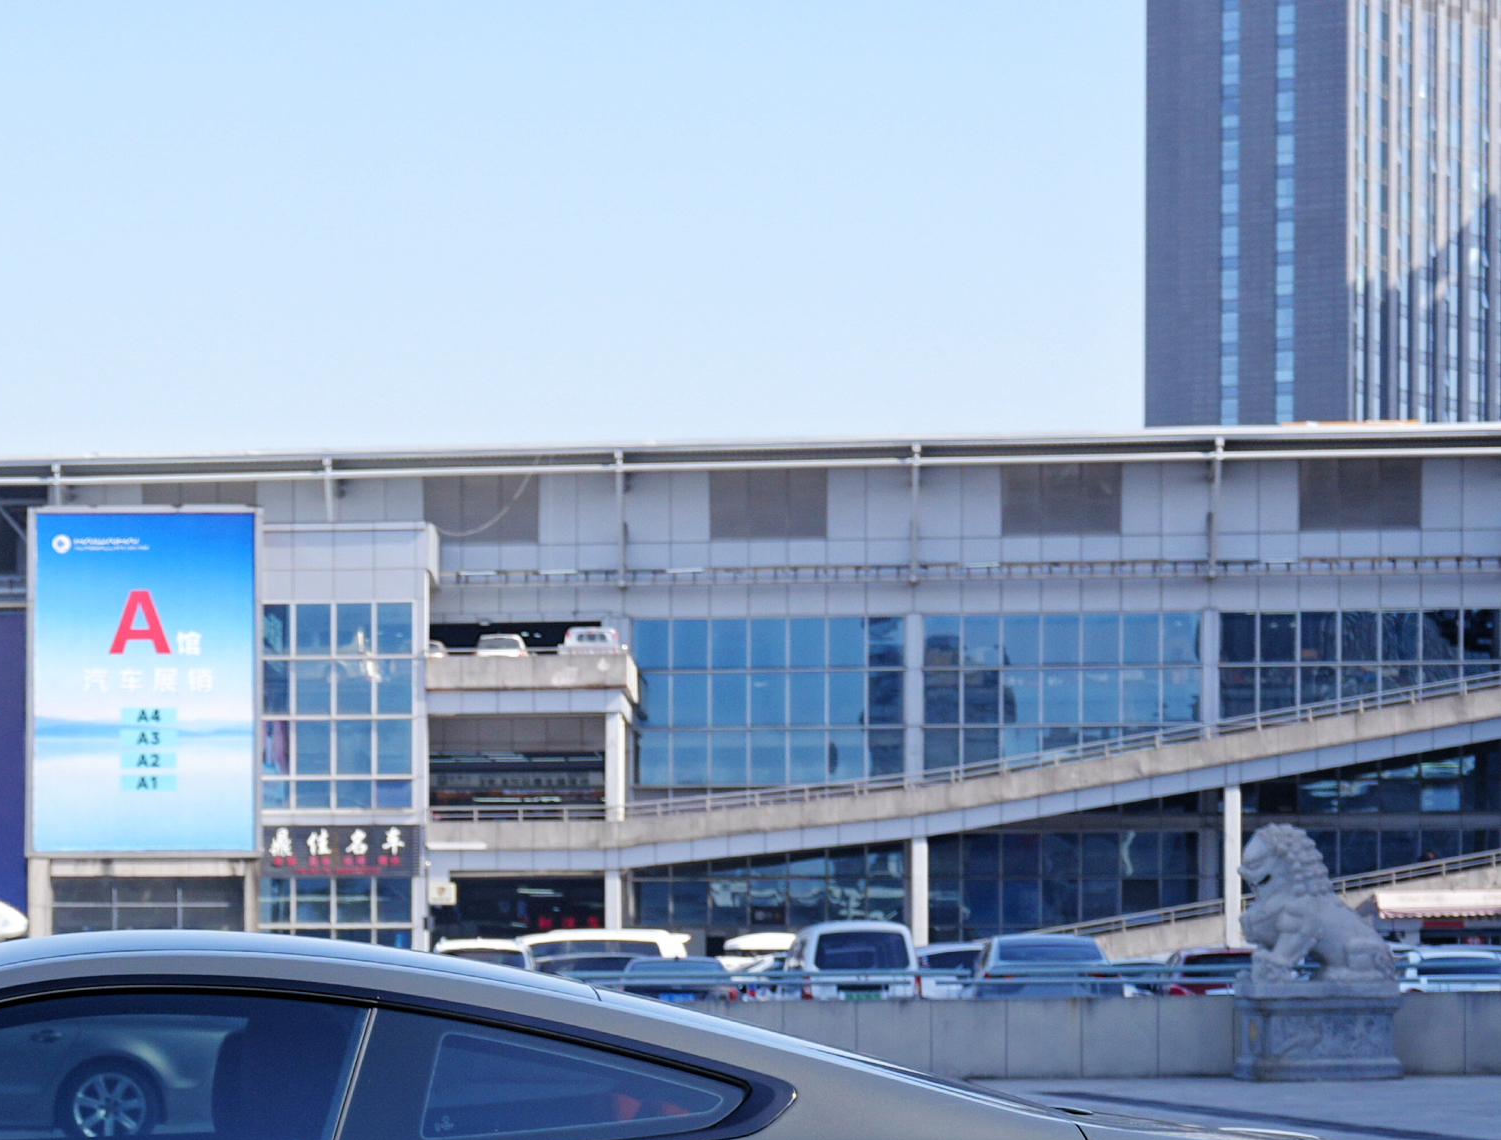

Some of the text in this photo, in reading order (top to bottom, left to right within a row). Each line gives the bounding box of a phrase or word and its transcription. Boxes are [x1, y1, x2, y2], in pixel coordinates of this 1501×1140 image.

[83, 667, 214, 693] 汽车展销
[137, 709, 161, 723] A4
[136, 731, 160, 746] A3
[136, 753, 160, 768] A2
[136, 776, 158, 790] A1
